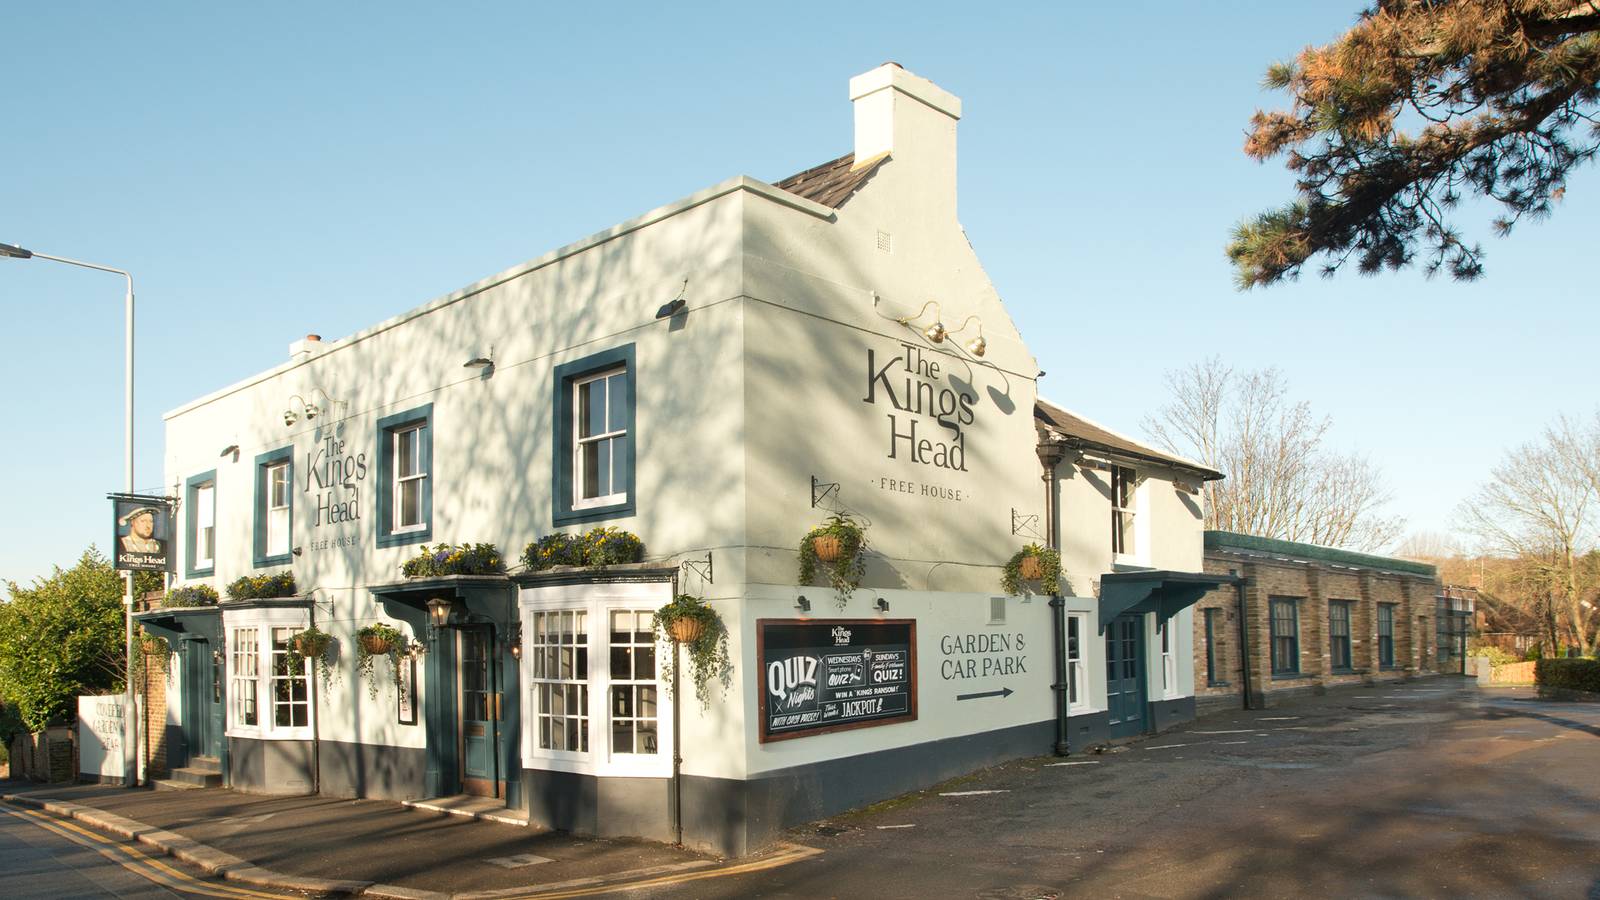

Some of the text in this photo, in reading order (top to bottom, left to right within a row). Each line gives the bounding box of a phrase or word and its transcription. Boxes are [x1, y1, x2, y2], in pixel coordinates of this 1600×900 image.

[901, 343, 940, 380] The
[863, 349, 975, 442] Kings
[324, 437, 345, 458] The
[887, 414, 969, 472] Head
[304, 448, 367, 497] Kings
[880, 477, 962, 502] FREE HOUSE
[315, 487, 361, 527] Head
[331, 535, 356, 550] HOUSE
[119, 554, 166, 565] Kings Head
[831, 628, 852, 638] Kings
[940, 633, 1011, 656] GARDEN
[827, 656, 861, 664] WEDNESDAYS
[875, 653, 899, 662] SUNDAYS
[941, 655, 1027, 680] CAR PARK
[768, 656, 818, 701] QUIZ
[787, 688, 816, 709] Nights
[835, 691, 848, 699] WIN
[841, 699, 877, 718] JACKPOT
